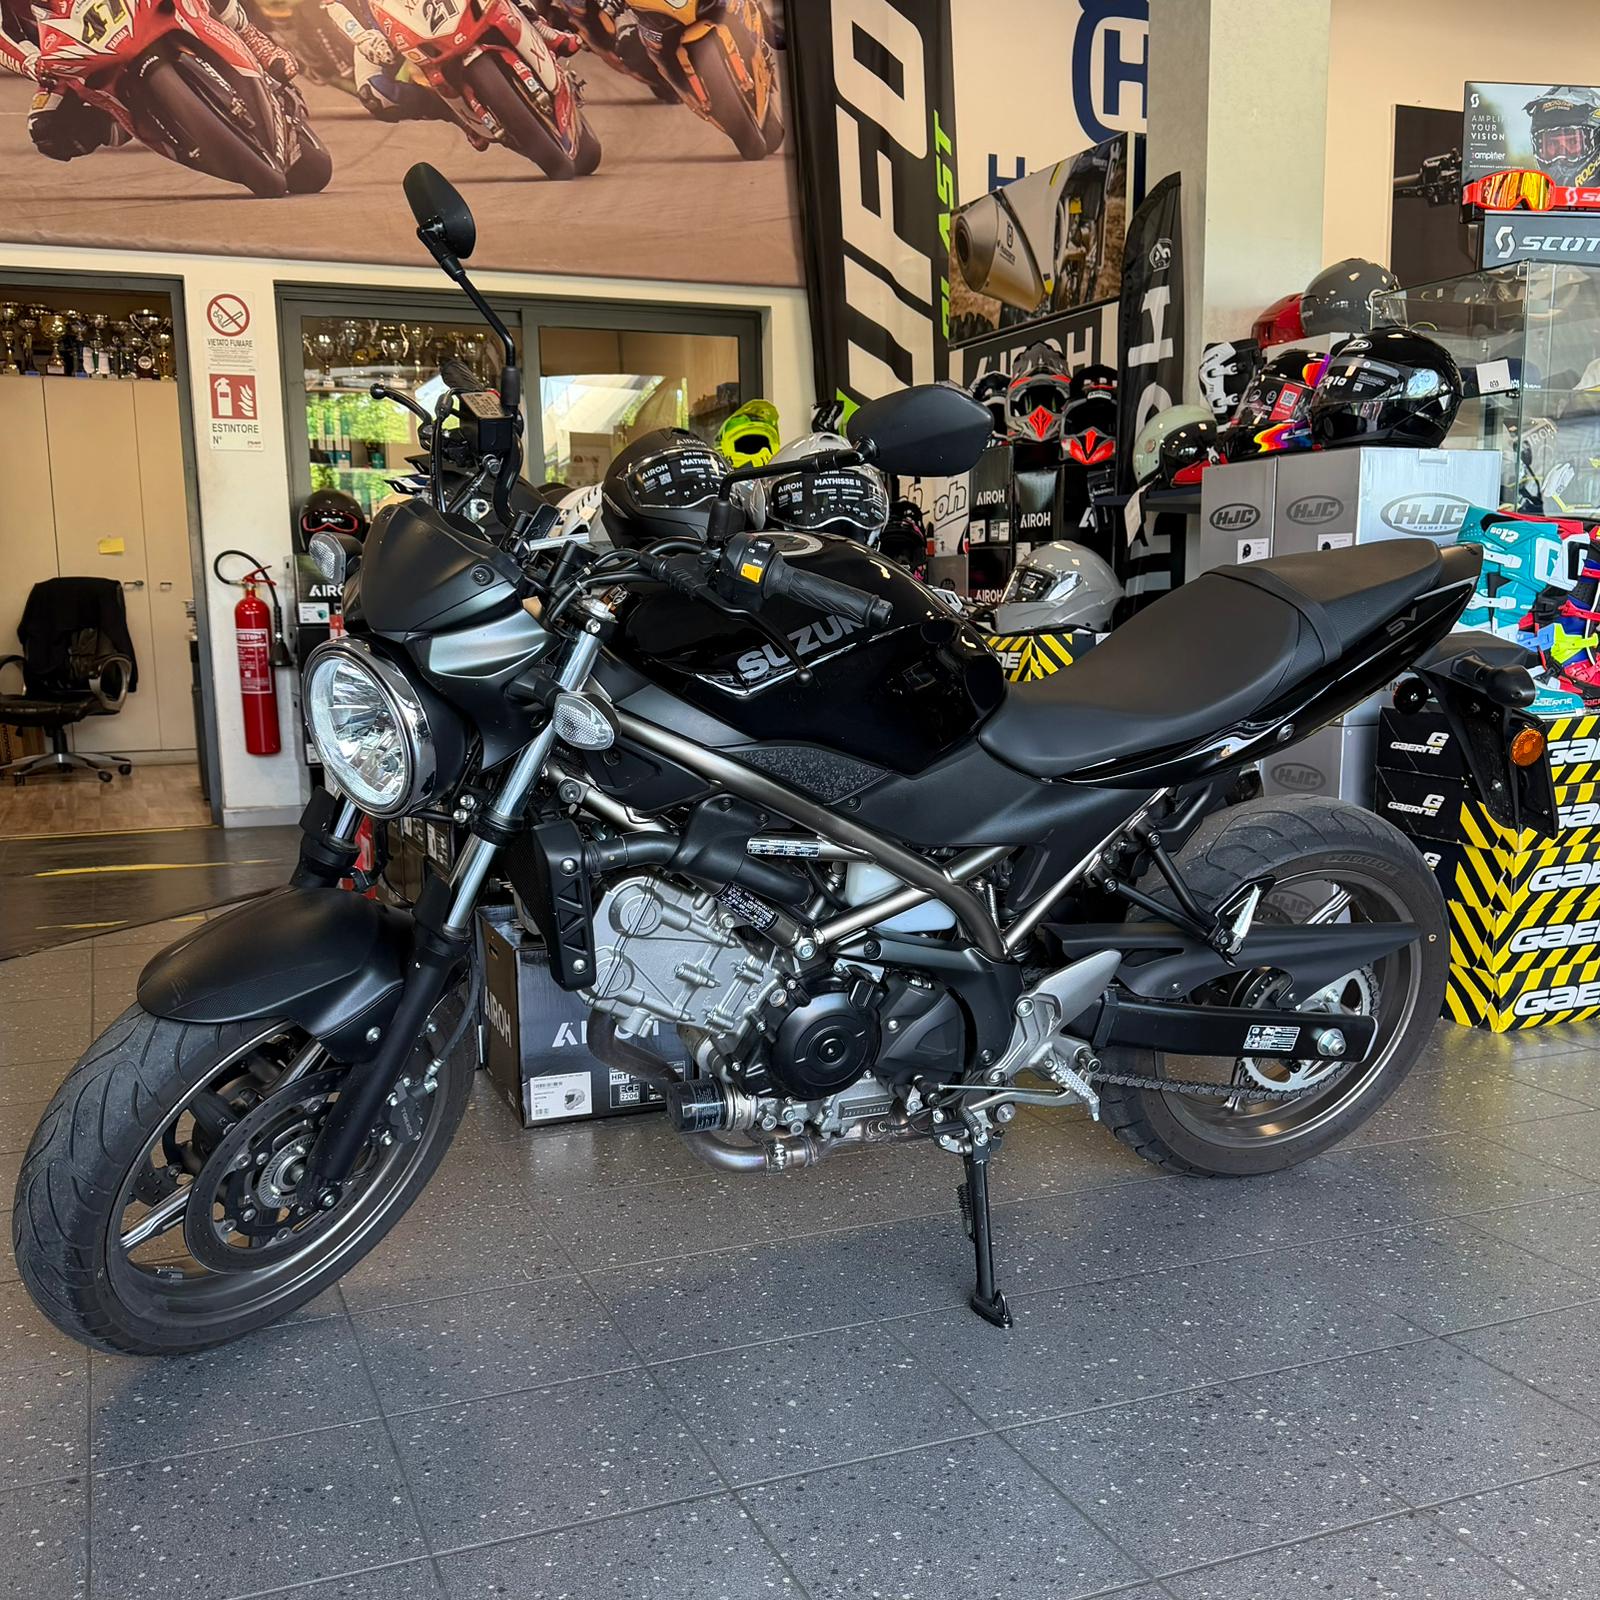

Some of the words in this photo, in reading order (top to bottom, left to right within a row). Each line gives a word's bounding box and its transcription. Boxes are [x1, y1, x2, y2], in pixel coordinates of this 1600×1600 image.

[422, 0, 459, 35] 21
[1471, 123, 1497, 131] YOUR
[1471, 132, 1505, 141] VISION
[207, 338, 228, 346] VIETATO
[230, 339, 253, 348] FUMARE
[212, 423, 260, 434] ESTINTORE
[642, 463, 669, 480] AIROH
[778, 481, 803, 493] AIROH
[814, 478, 855, 487] MATHISSE
[976, 489, 1006, 506] AIROH
[1216, 509, 1254, 525] HJC
[1293, 501, 1337, 518] HJC
[1393, 504, 1468, 525] HJC
[1020, 511, 1051, 529] AIROH
[975, 589, 1004, 603] AIROH
[1385, 607, 1418, 637] SV
[1278, 768, 1319, 786] HJC
[484, 985, 512, 1048] AIROH
[620, 1084, 639, 1093] ECE
